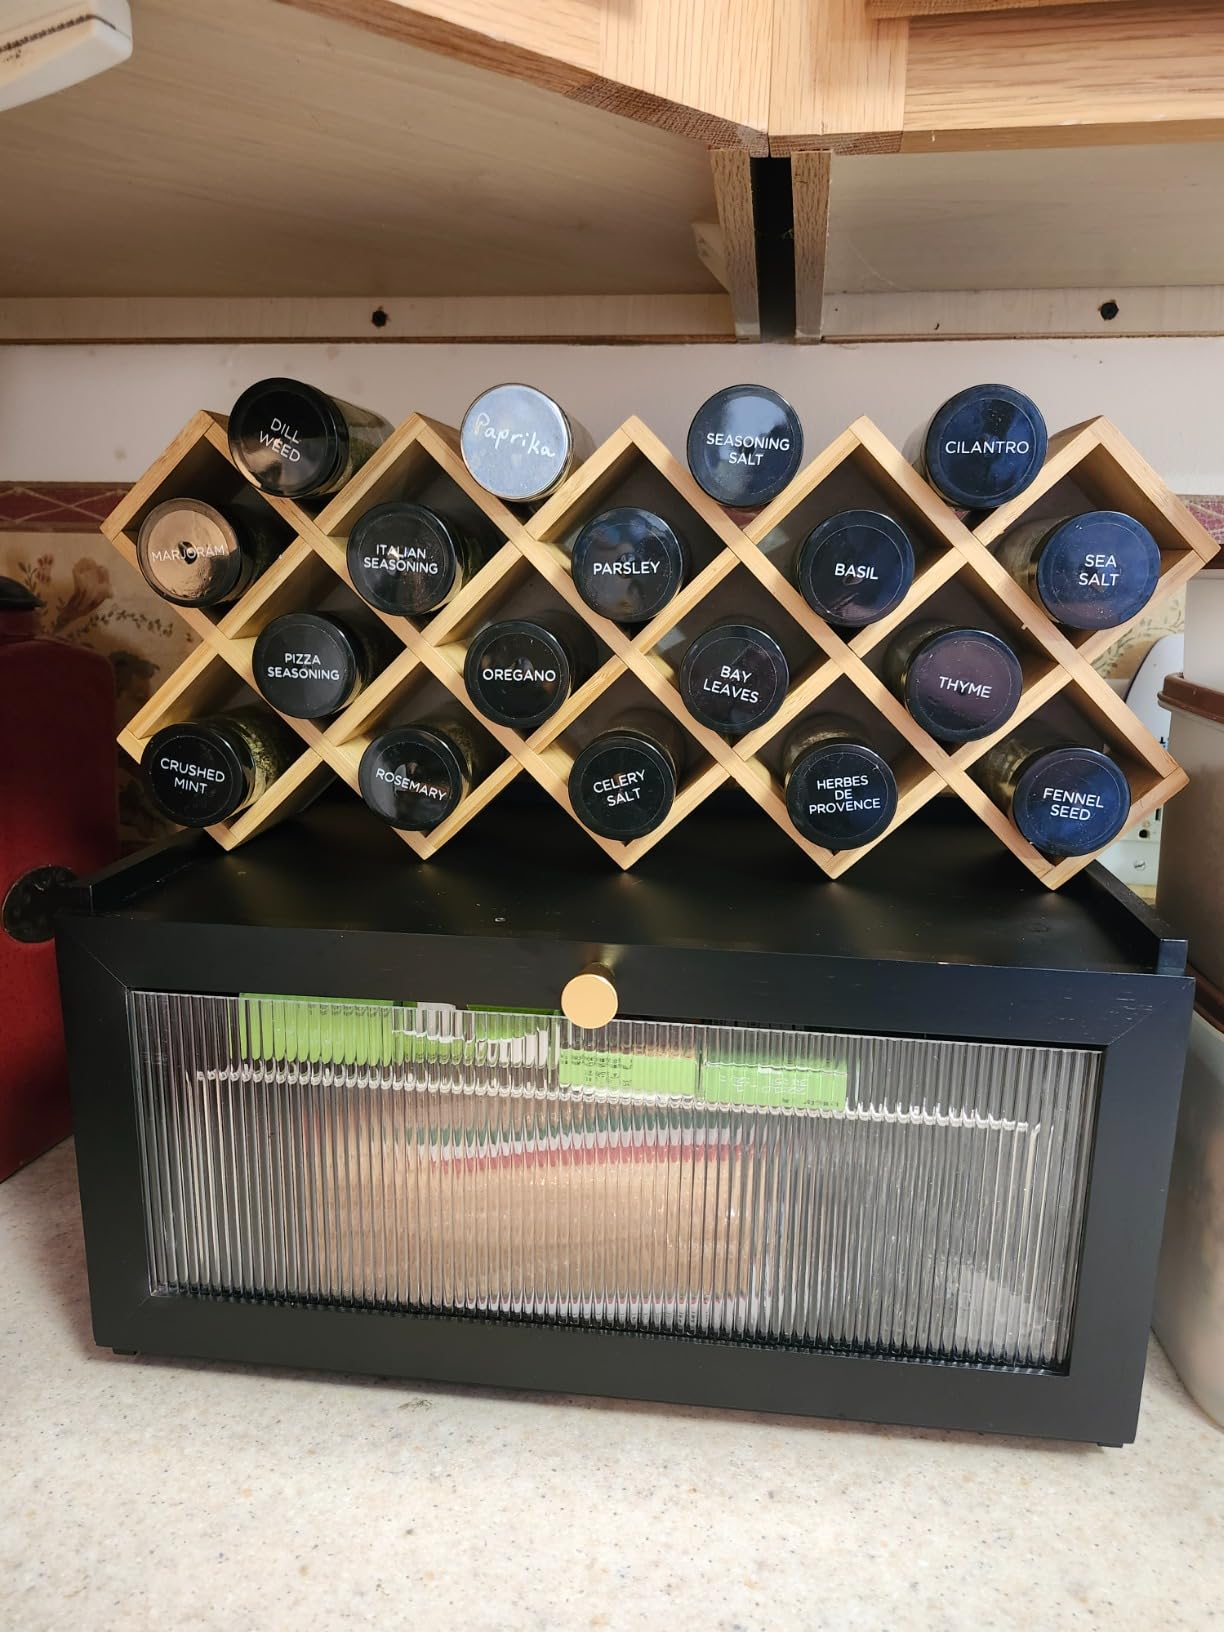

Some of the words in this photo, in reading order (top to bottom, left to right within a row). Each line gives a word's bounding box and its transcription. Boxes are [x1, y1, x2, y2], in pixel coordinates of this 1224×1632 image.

[270, 418, 300, 444] DILL
[473, 412, 556, 458] Paprika
[259, 431, 301, 463] WEED
[706, 432, 790, 451] SEASONING
[945, 441, 1030, 454] CILANTRO
[728, 452, 763, 466] SALT
[151, 544, 225, 562] MARJORAM
[376, 544, 426, 559] ITALIAN
[363, 557, 439, 575] SEASONING
[593, 561, 661, 576] PARSLEY
[1084, 554, 1117, 568] SEA
[834, 563, 879, 580] BASIL
[1078, 573, 1120, 587] SALT
[285, 653, 321, 665] PIZZA
[267, 666, 340, 681] SEASONING
[482, 668, 556, 682] OREGANO
[720, 665, 753, 684] BAY
[703, 679, 759, 704] LEAVES
[938, 676, 993, 699] THYME
[160, 757, 225, 783] CRUSHED
[174, 777, 208, 795] MINT
[375, 767, 448, 801] ROSEMARY
[593, 770, 646, 794] CELERY
[816, 775, 869, 790] HERBES
[606, 788, 641, 807] SALT
[834, 788, 853, 800] DE
[1043, 787, 1105, 809] FENNEL
[808, 798, 881, 815] PROVENCE
[1050, 803, 1091, 821] SEED
